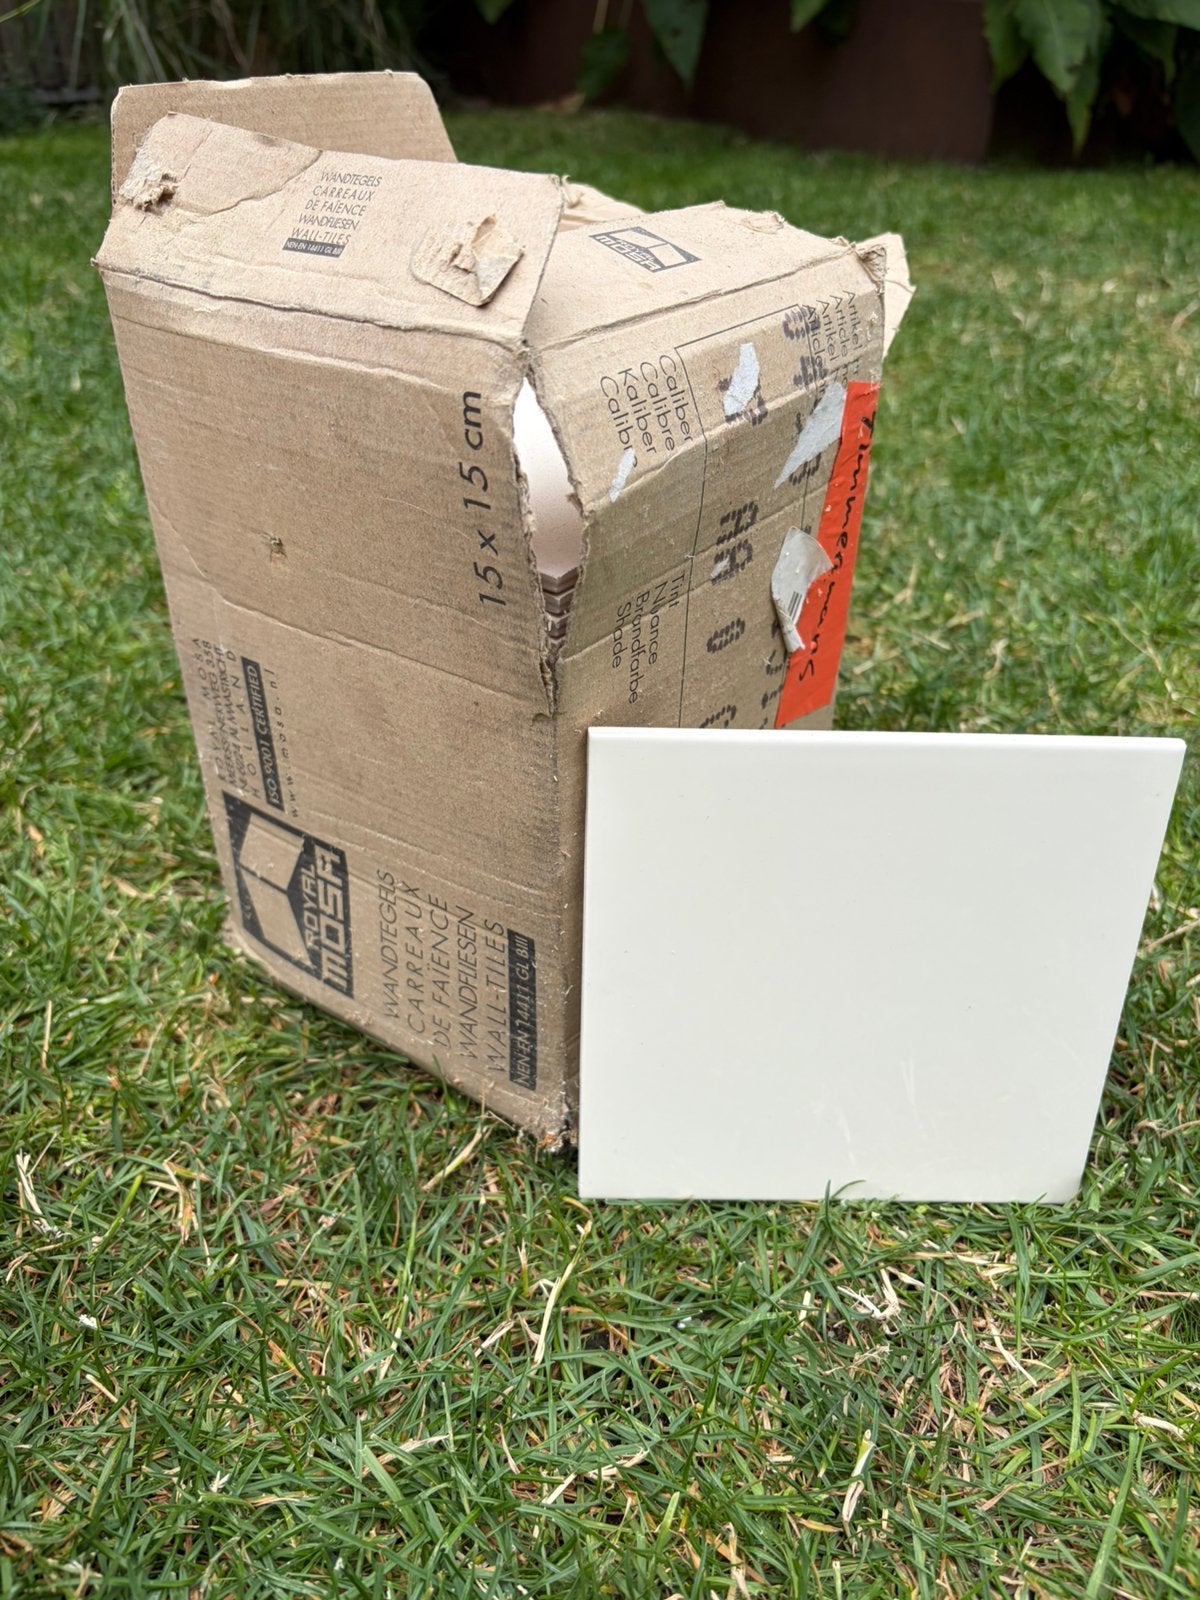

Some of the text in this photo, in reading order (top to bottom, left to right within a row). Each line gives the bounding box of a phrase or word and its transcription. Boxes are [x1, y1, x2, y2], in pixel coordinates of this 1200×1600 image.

[299, 214, 360, 230] WANDFLIESEN
[305, 200, 319, 210] DE
[312, 185, 375, 202] CARREAUX
[320, 171, 382, 187] WANDTEGELS
[291, 227, 351, 245] WALL-TILES
[816, 300, 840, 361] Artikel
[829, 295, 850, 357] Article
[843, 290, 863, 350] Artikel
[618, 368, 657, 454] Kaliber
[640, 362, 675, 451] Calibre
[659, 355, 693, 442] Caliber
[459, 391, 506, 606] 15 x 15 cm
[648, 580, 669, 666] Nuance
[668, 573, 685, 609] Tint
[192, 638, 211, 700] MOSA
[202, 639, 215, 668] 358
[612, 601, 632, 669] Shade
[629, 590, 650, 705] Brandfarbe
[227, 651, 261, 799] HOLLAND
[247, 665, 279, 804] ISO 9001 CERTIFIED
[302, 863, 320, 949] ROYAL
[378, 869, 400, 1019] WANDTEGELS
[401, 880, 426, 1034] CARREAUX
[428, 894, 452, 1048] DE FAÏENCE
[456, 905, 479, 1059] WANDFLIESEN
[485, 918, 508, 1072] WALL-TILES
[517, 962, 531, 980] GL
